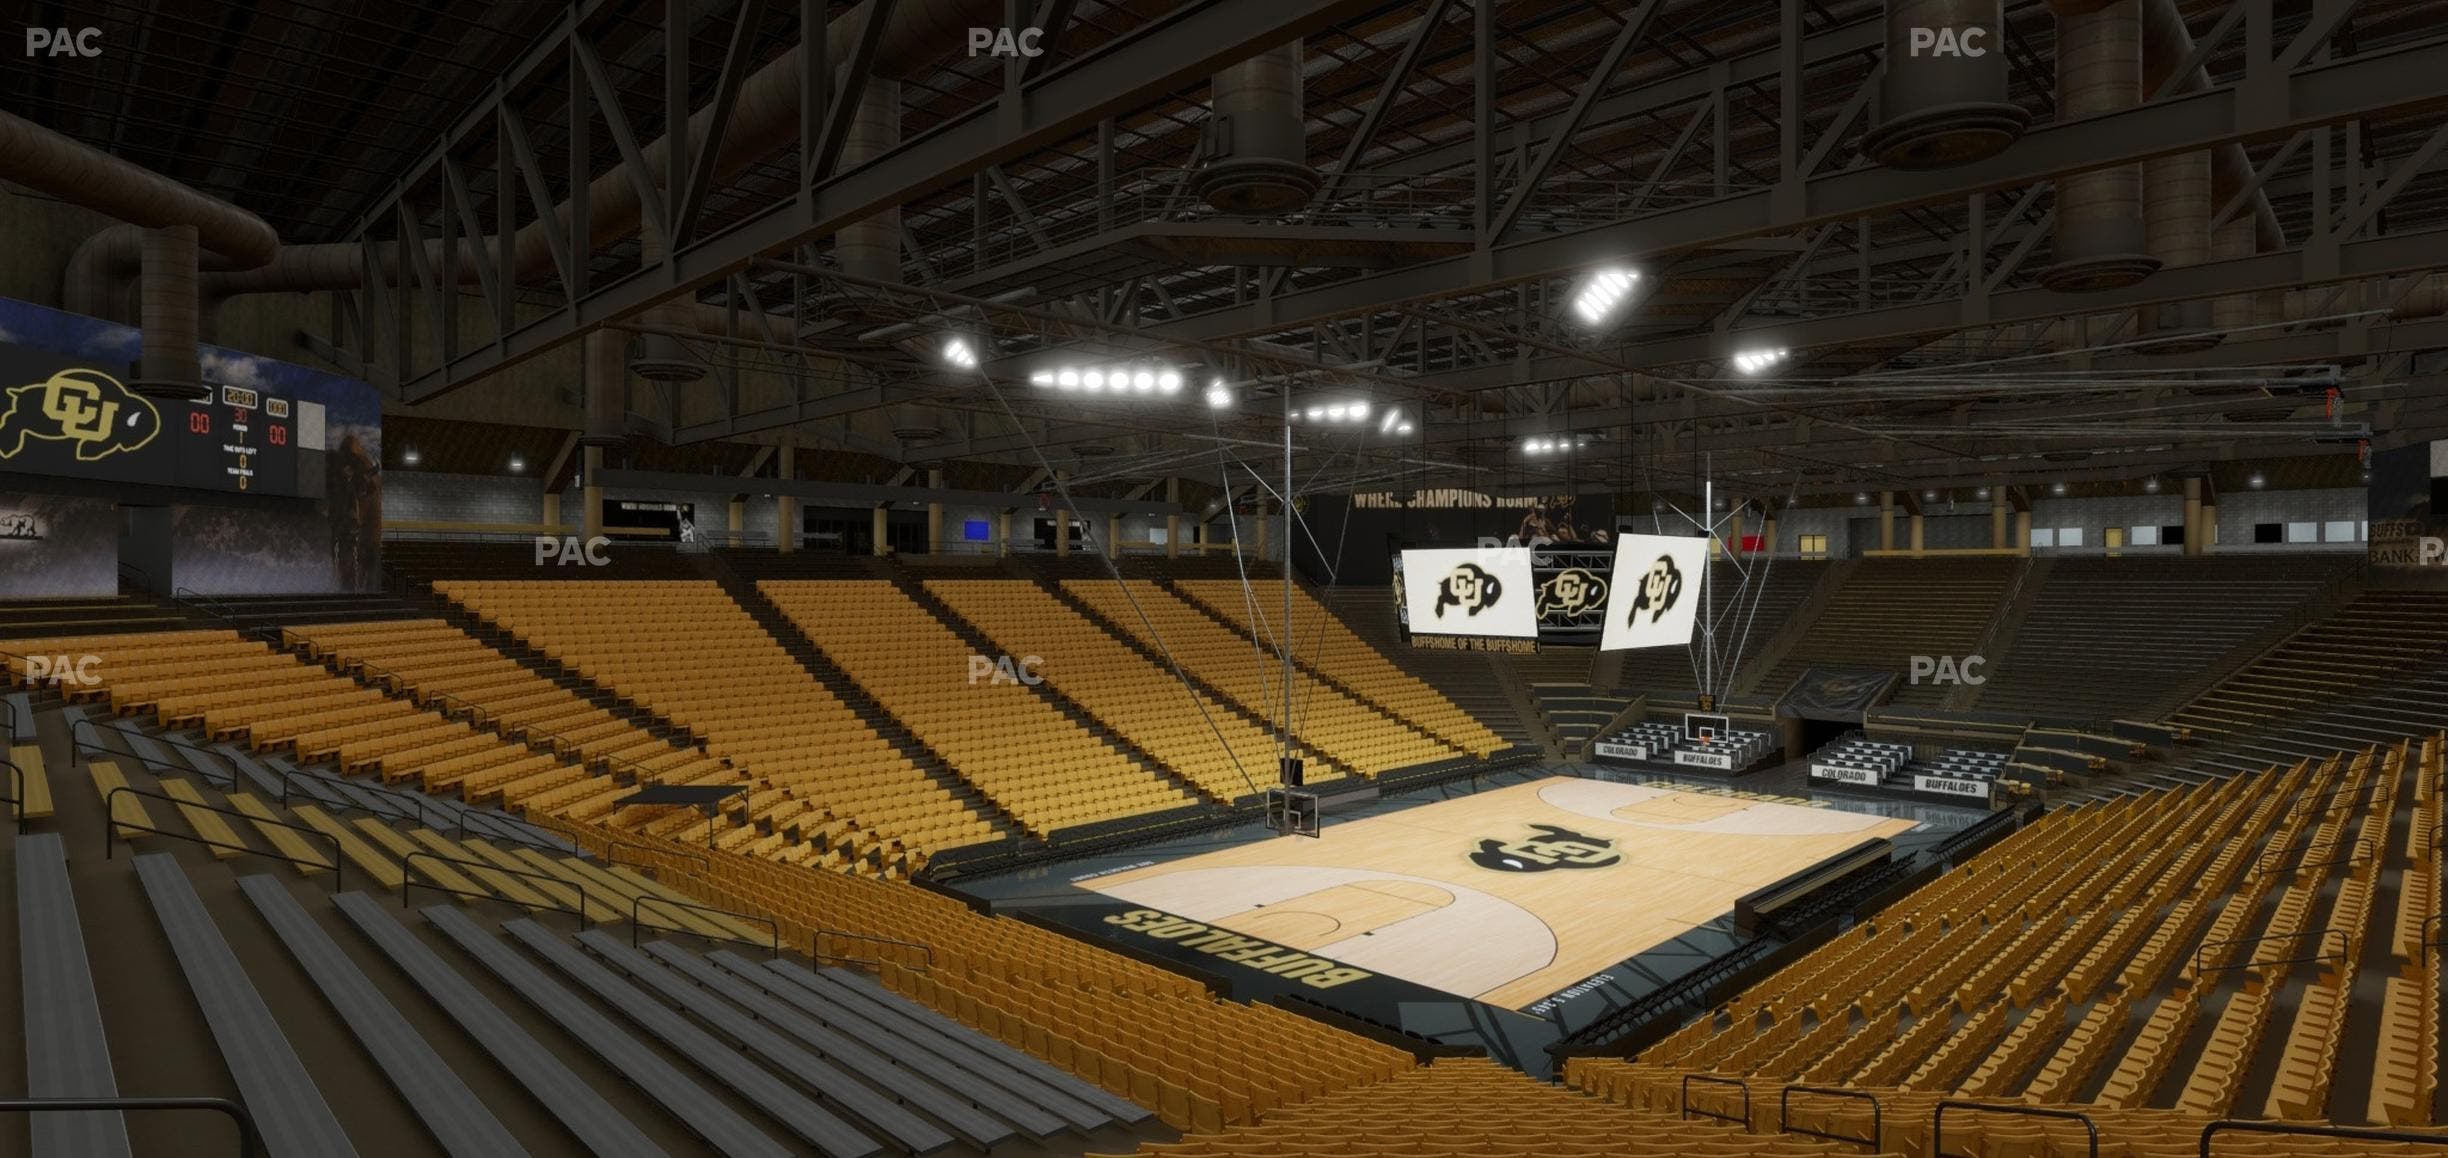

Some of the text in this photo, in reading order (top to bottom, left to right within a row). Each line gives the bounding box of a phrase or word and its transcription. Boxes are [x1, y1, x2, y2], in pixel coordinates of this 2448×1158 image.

[190, 412, 210, 434] 00
[269, 424, 287, 446] 00
[1822, 768, 1866, 782] COLORADO
[1925, 778, 1978, 794] BUFFALOES
[1103, 909, 1374, 989] BUFFALOES
